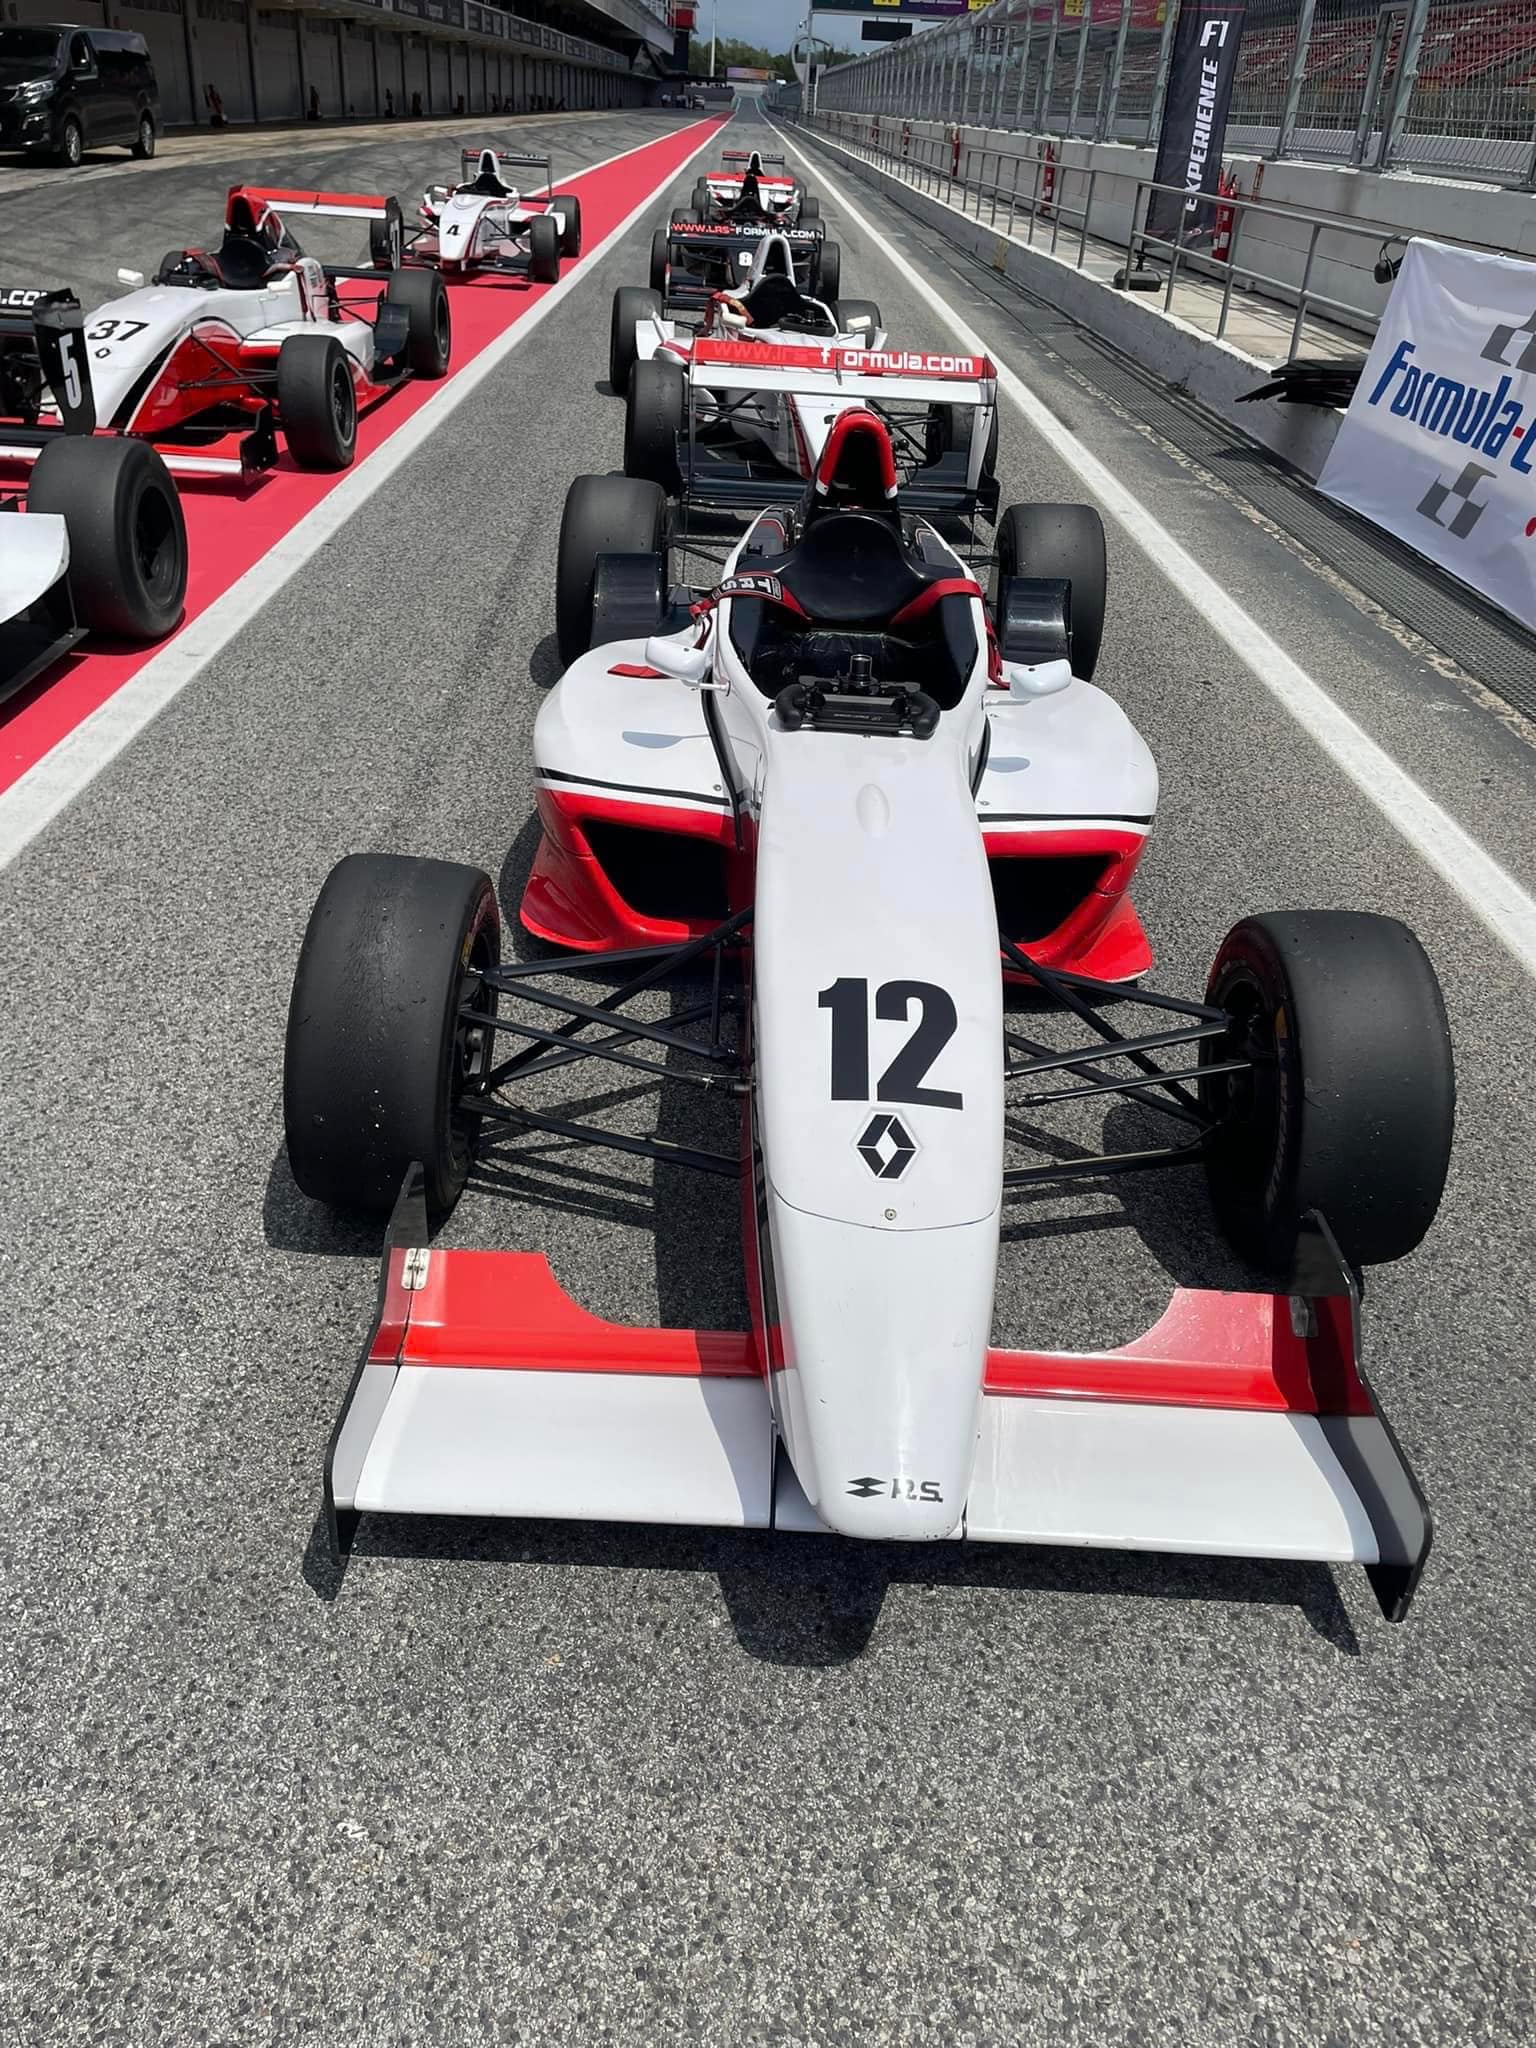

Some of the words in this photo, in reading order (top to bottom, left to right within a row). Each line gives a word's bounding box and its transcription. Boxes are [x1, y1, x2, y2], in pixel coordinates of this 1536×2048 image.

[1200, 20, 1229, 47] F1
[1184, 57, 1219, 212] EXPERIENCE
[446, 224, 460, 236] 4
[738, 251, 753, 267] 8
[87, 319, 150, 342] 37
[59, 333, 82, 409] 5
[817, 977, 964, 1112] 12
[890, 1477, 944, 1504] RS
